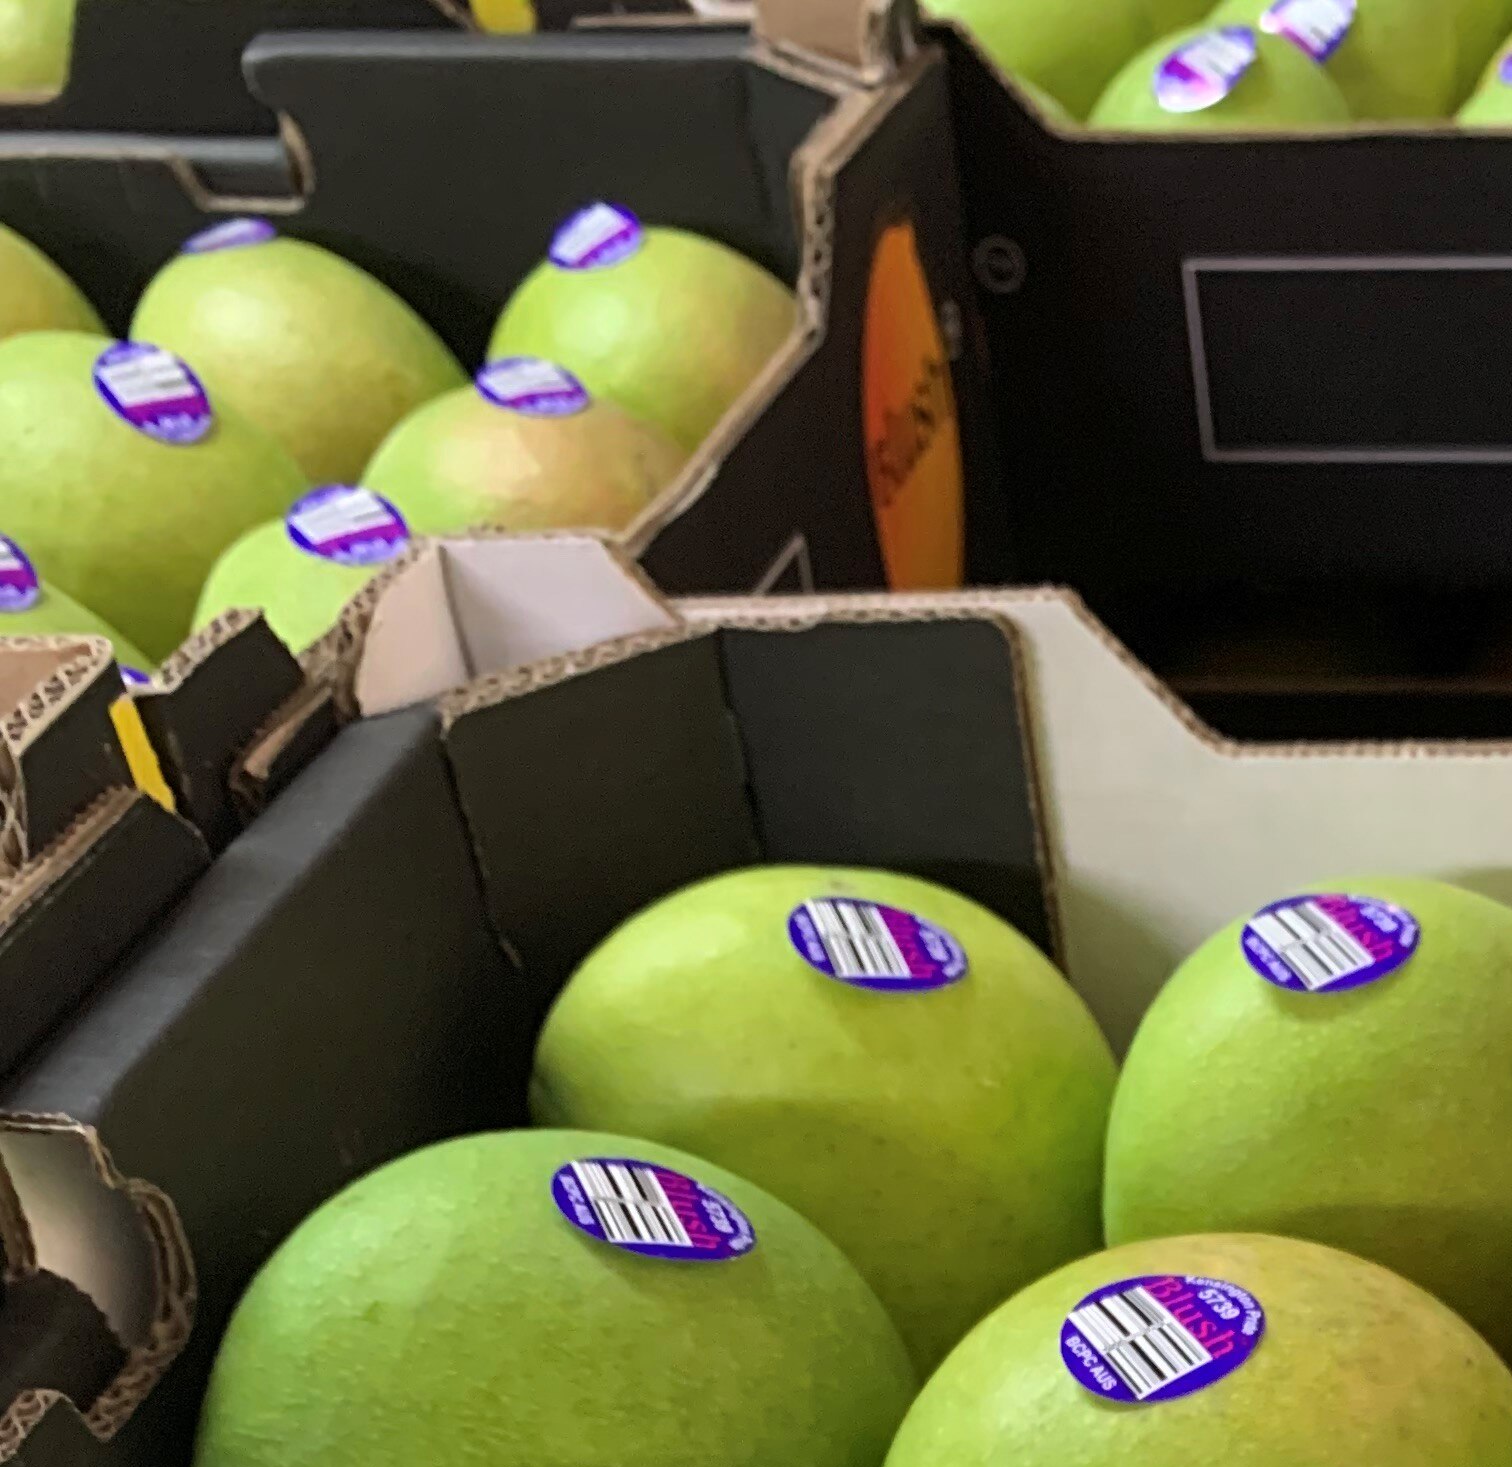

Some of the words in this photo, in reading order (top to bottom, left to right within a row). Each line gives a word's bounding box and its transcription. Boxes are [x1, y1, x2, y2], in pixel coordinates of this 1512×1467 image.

[1143, 1276, 1235, 1359] Blush
[1197, 1288, 1241, 1320] 5739
[1065, 1334, 1099, 1368] BCPC
[1089, 1365, 1118, 1391] AUS
